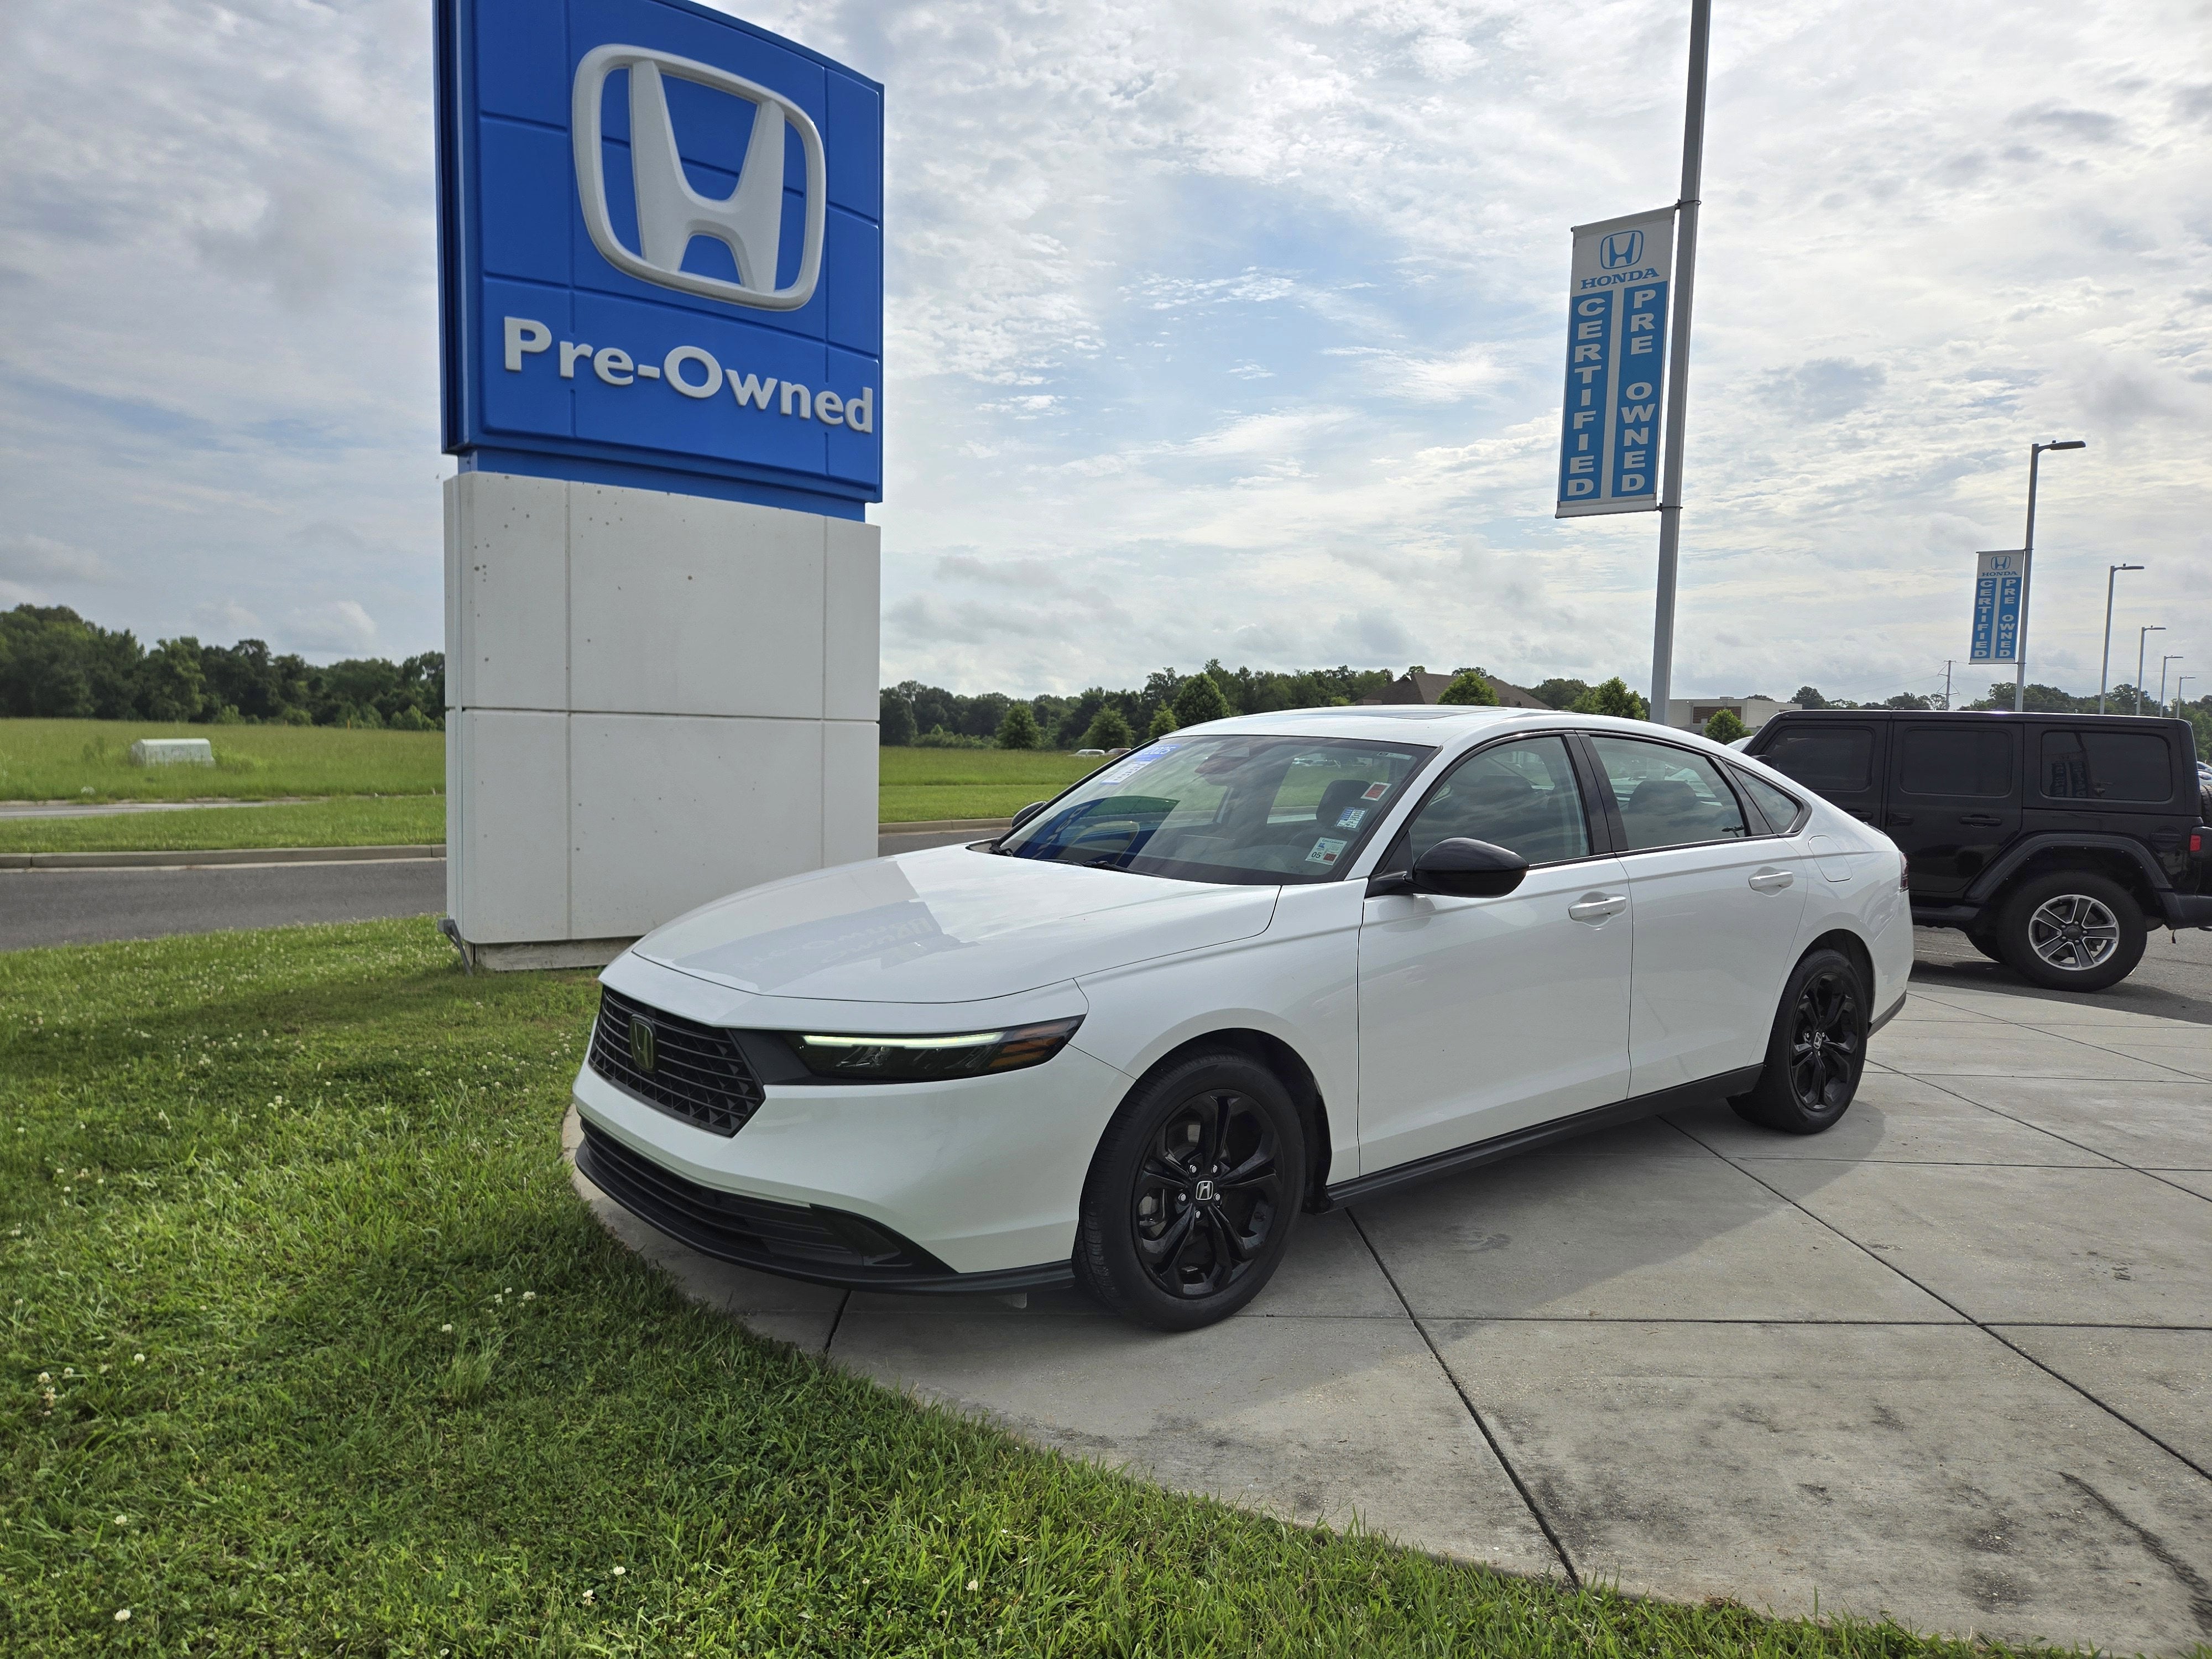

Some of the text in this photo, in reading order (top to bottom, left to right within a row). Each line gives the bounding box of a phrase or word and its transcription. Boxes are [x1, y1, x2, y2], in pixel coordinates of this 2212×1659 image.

[1580, 267, 1660, 289] HONDA
[504, 316, 873, 434] Pre-Owned
[1567, 297, 1605, 497] CERTIFIED
[1621, 289, 1656, 492] PRE OWNED
[1974, 580, 1994, 657] CERTIFIED
[1999, 579, 2016, 657] PRE OWNED
